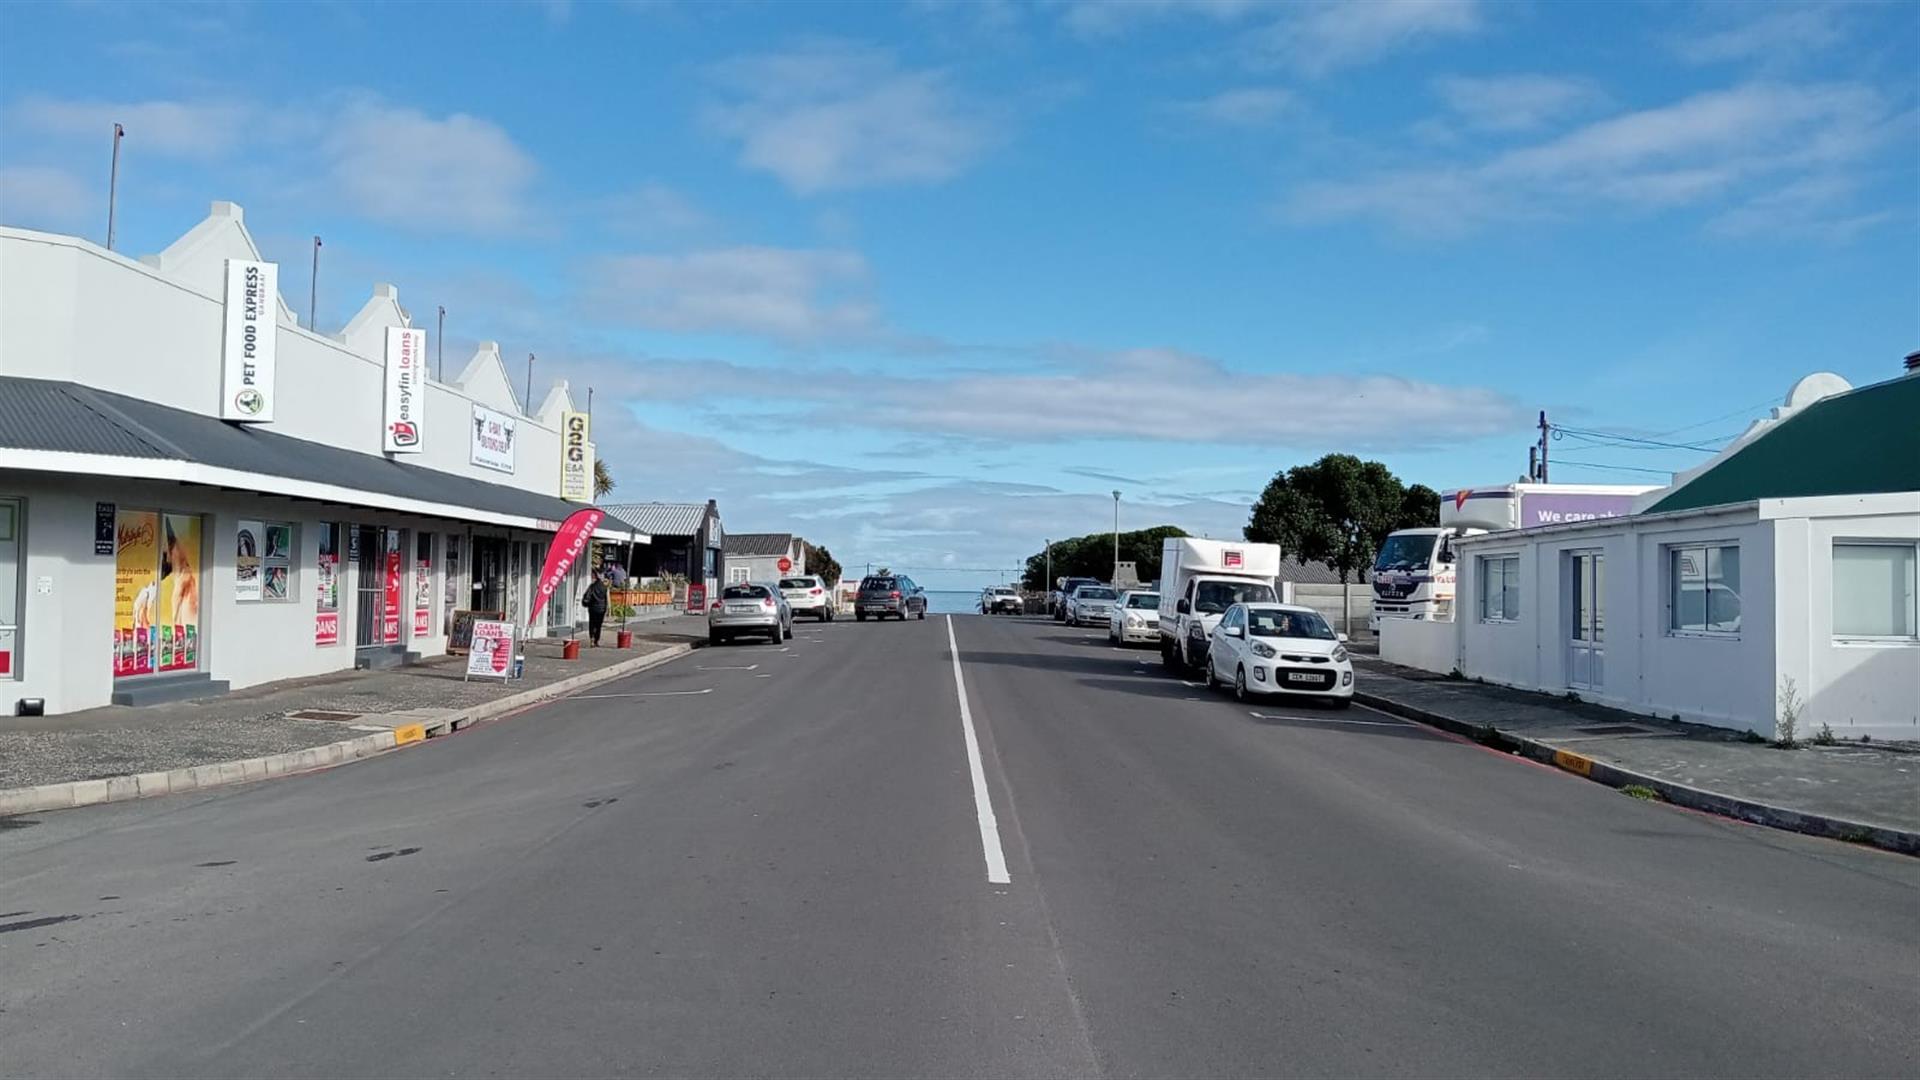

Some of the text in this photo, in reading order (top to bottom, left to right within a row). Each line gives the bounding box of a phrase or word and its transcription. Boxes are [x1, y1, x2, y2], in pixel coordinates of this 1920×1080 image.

[243, 266, 259, 385] PET FOOD EXPRESS
[398, 332, 412, 420] easyfin loans
[542, 558, 571, 595] Cash
[565, 513, 599, 557] Loans
[1537, 509, 1561, 522] We
[1564, 512, 1596, 522] care
[475, 629, 503, 637] LOANS
